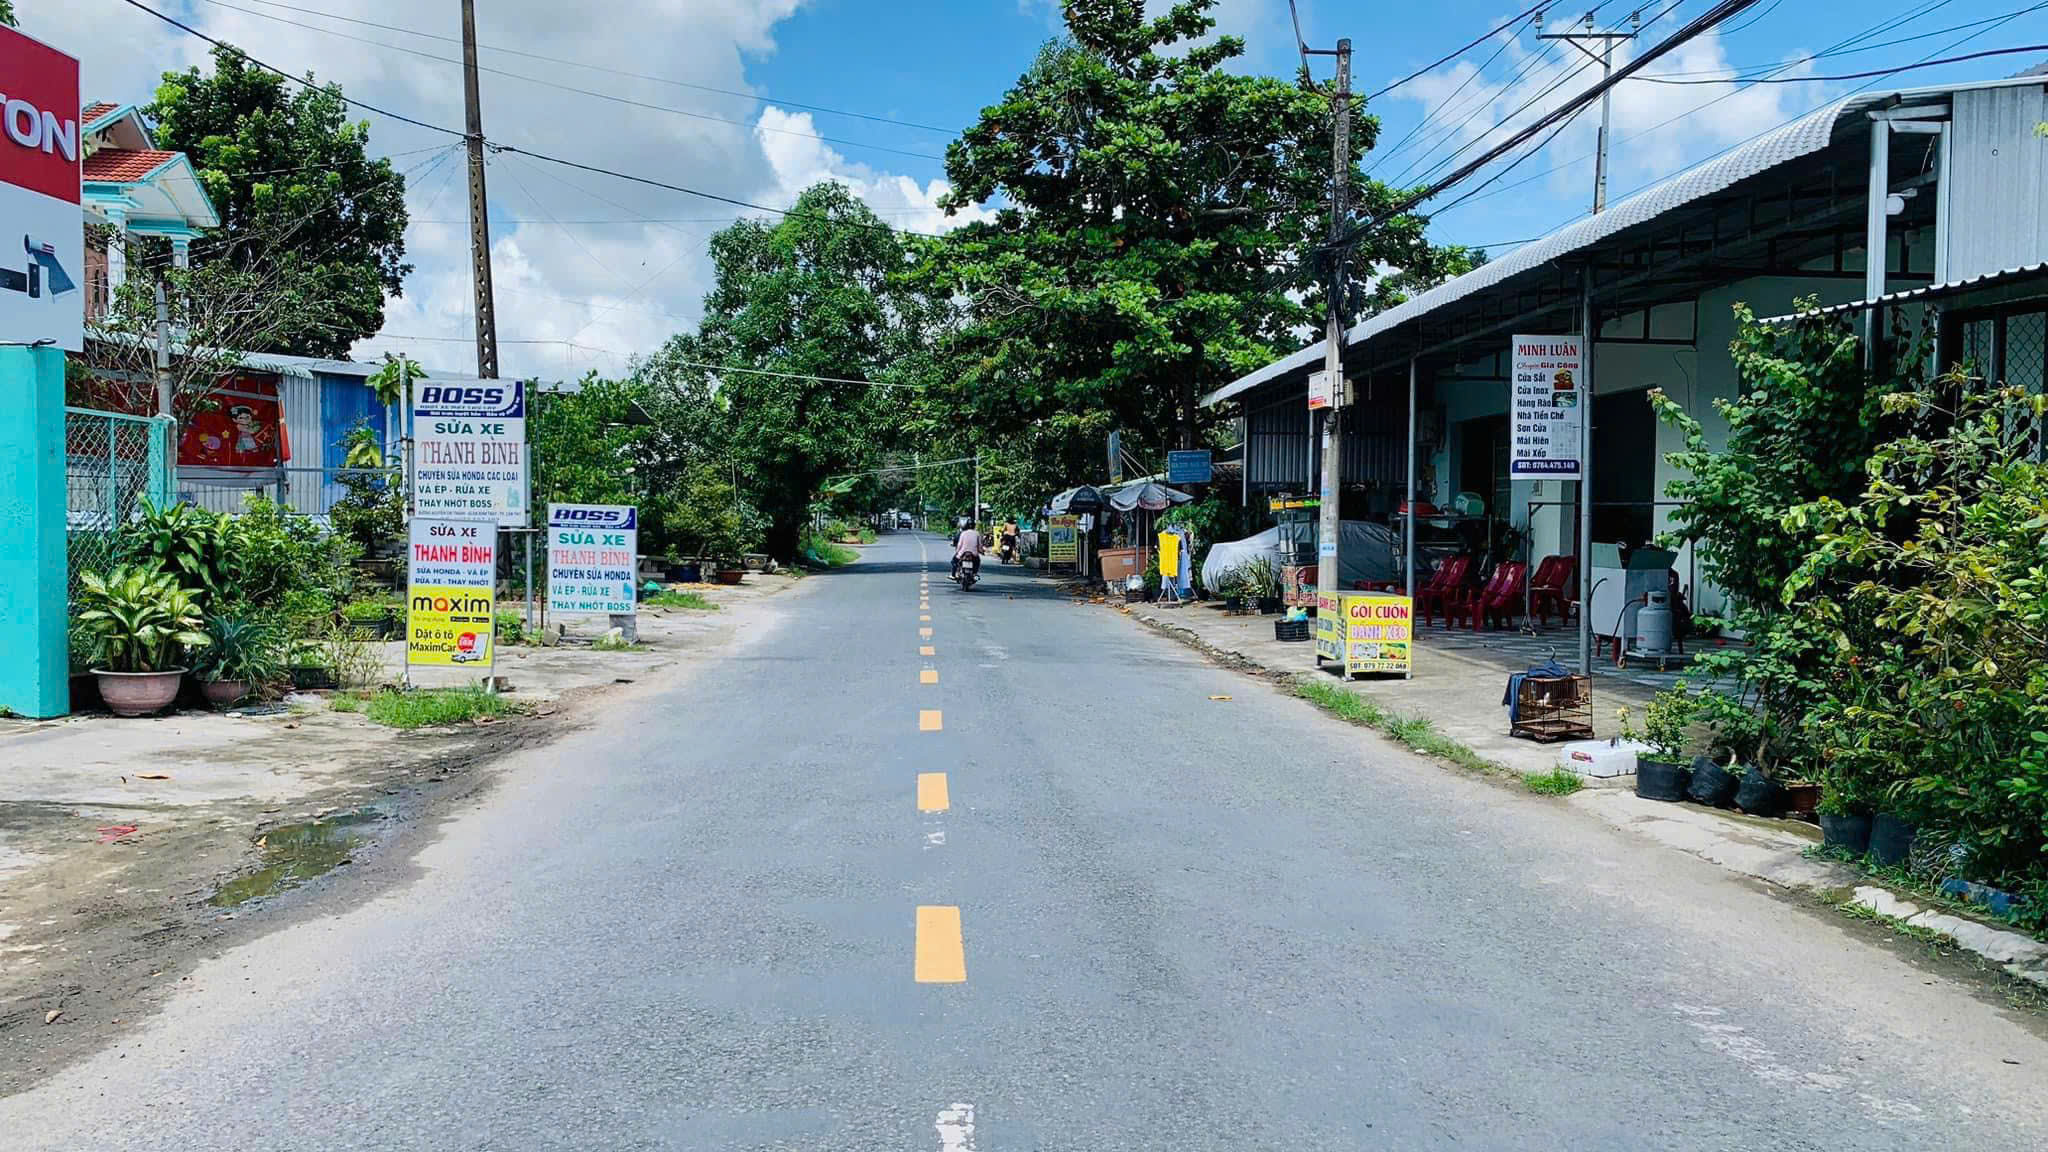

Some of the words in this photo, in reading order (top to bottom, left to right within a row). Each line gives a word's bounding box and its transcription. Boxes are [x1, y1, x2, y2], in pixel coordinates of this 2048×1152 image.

[0, 92, 76, 162] ON
[1517, 344, 1546, 356] MINH
[1550, 341, 1577, 356] LUÂN
[421, 387, 504, 405] BOSS
[1533, 386, 1549, 395] Inox
[1537, 398, 1551, 407] Rào
[1517, 411, 1532, 420] Nhà
[1550, 409, 1565, 420] Chế
[435, 419, 473, 434] SỬA
[480, 423, 505, 435] XE
[1533, 422, 1547, 433] Cửa
[421, 441, 476, 465] THANH
[481, 436, 519, 465] BÌNH
[1533, 447, 1547, 458] Xếp
[418, 468, 446, 480] CHUYÊN
[462, 471, 485, 481] HONDA
[478, 486, 491, 495] XE
[418, 499, 441, 508] THAY
[470, 500, 492, 508] BOSS
[554, 509, 620, 521] BOSS
[430, 522, 456, 536] SỬA
[461, 527, 477, 537] XE
[558, 529, 595, 545] SỬA
[602, 534, 626, 546] XE
[415, 544, 457, 562] THANH
[462, 541, 492, 564] BÌNH
[552, 550, 596, 565] THANH
[600, 547, 630, 566] BÌNH
[433, 567, 460, 575] HONDA
[552, 567, 585, 580] CHUYÊN
[586, 566, 602, 580] SỬA
[604, 570, 631, 580] HONDA
[600, 586, 610, 597] XE
[412, 593, 490, 613] maxim
[552, 600, 576, 609] THAY
[607, 602, 631, 611] BOSS
[1350, 601, 1372, 618] GỎI
[1376, 602, 1409, 619] CUỐN
[415, 628, 432, 641] Đặt
[434, 630, 441, 639] ô
[443, 629, 454, 639] tô
[1352, 621, 1382, 640] BÁNH
[409, 642, 457, 652] MaximCar
